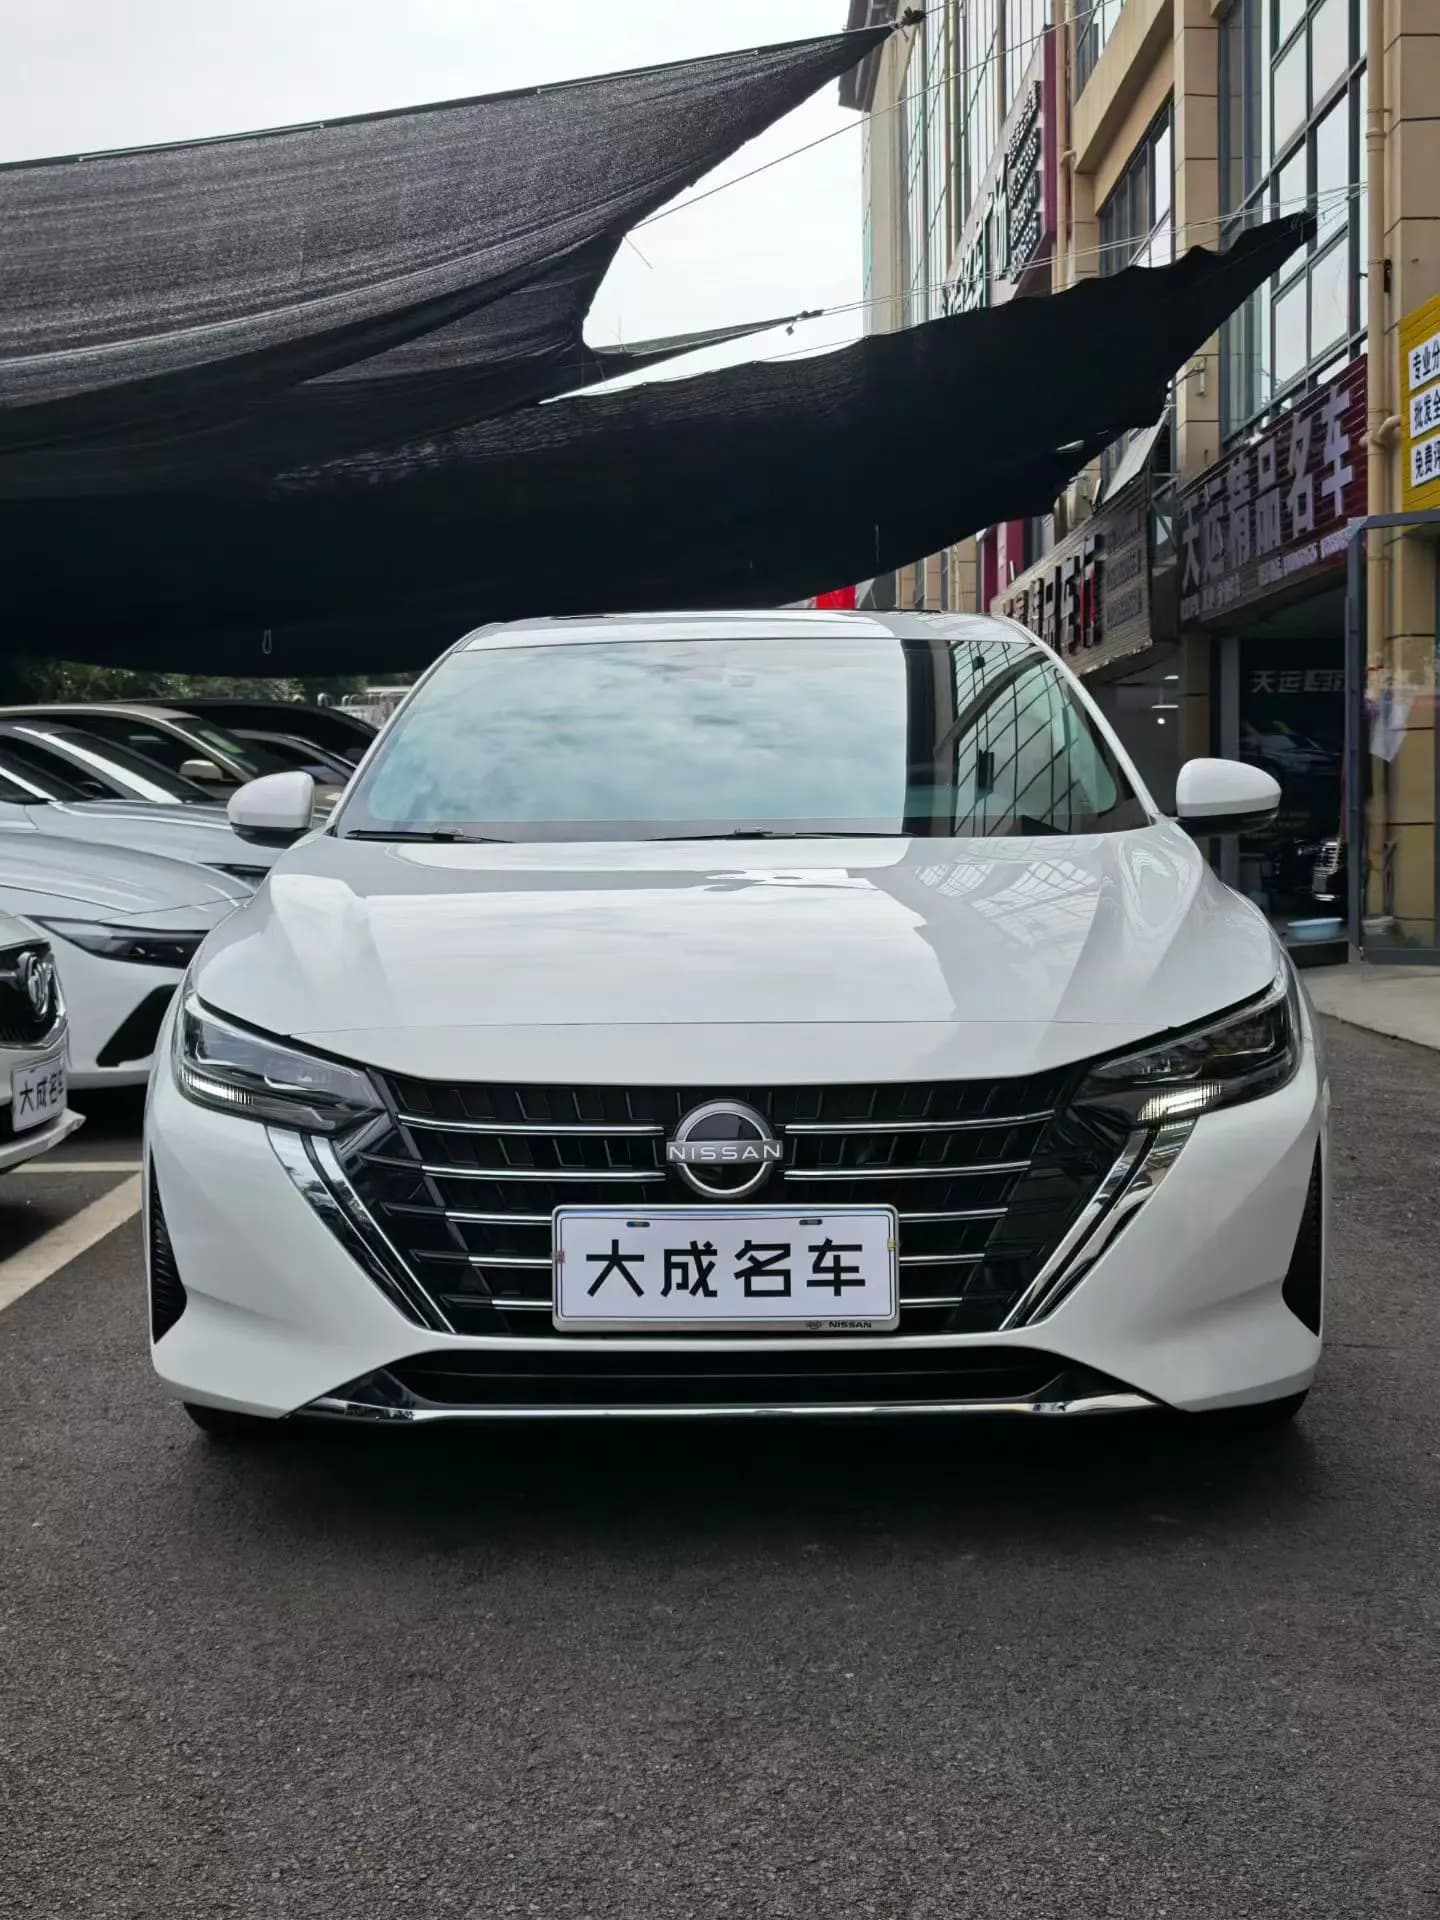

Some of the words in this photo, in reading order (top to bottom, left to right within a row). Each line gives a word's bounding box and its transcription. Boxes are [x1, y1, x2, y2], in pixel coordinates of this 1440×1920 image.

[669, 1144, 780, 1160] NISSAN
[586, 1238, 865, 1297] 大成名车
[828, 1321, 872, 1329] NISSAN
